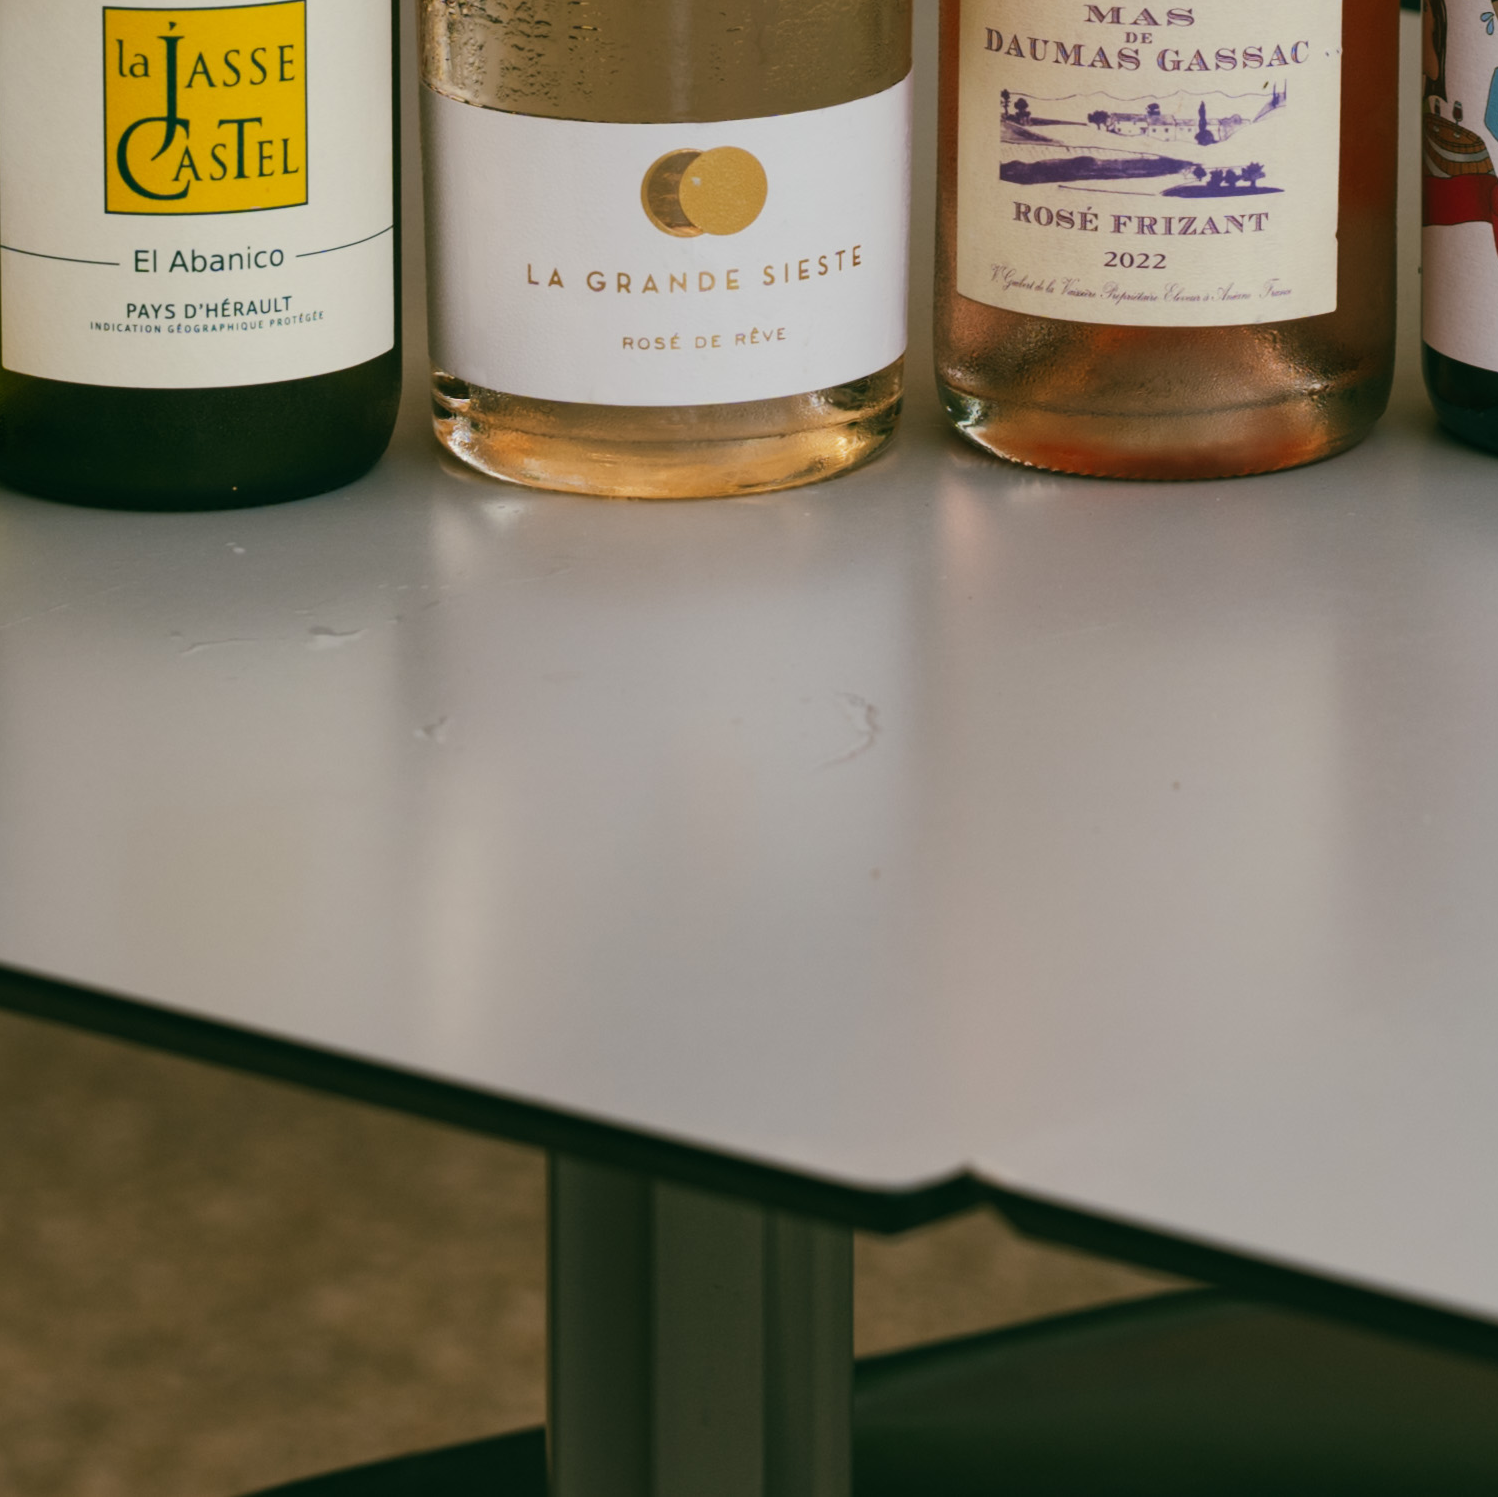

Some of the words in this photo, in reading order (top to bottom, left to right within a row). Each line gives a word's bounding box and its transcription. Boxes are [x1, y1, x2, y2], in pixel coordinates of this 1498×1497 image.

[1084, 4, 1196, 27] MAS
[984, 26, 1142, 72] DAUMAS
[1156, 40, 1310, 72] GASSAC
[1125, 32, 1153, 45] DE
[116, 39, 151, 79] la
[1012, 201, 1099, 233] ROSÉ
[1110, 211, 1270, 236] FRIZANT
[134, 249, 158, 273] El
[169, 246, 285, 273] Abanico
[526, 263, 565, 288] LA
[586, 269, 740, 294] GRANDE
[762, 244, 864, 286] SIESTE
[1104, 251, 1167, 270] 2022
[90, 321, 162, 334] INDICATION
[167, 320, 264, 334] GÉOGRAPHIQUE
[269, 310, 325, 328] PROTÉGÉE
[126, 303, 176, 320] PAYS
[622, 332, 681, 350] ROSÉ
[694, 334, 722, 350] DE
[735, 327, 787, 346] RÊVE
